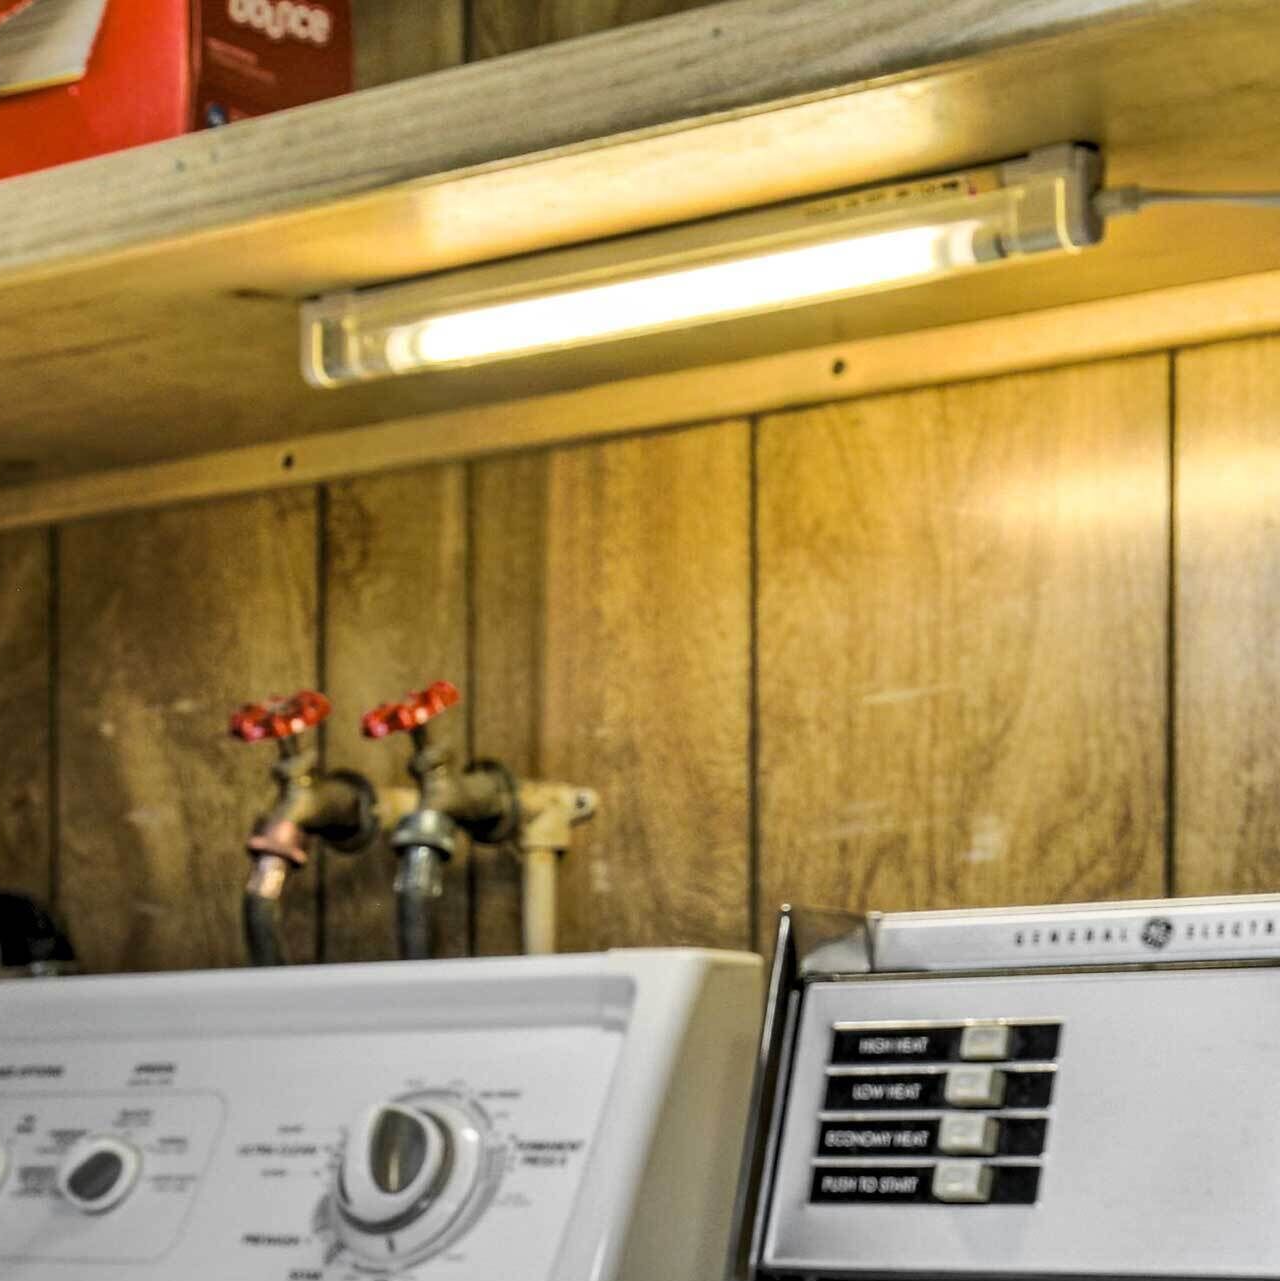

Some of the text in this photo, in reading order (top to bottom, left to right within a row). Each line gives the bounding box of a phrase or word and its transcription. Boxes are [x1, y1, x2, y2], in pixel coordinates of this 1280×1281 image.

[1014, 929, 1127, 947] GENERAL
[852, 1083, 884, 1100] LOW
[858, 1175, 878, 1193] TO
[879, 1175, 920, 1193] START
